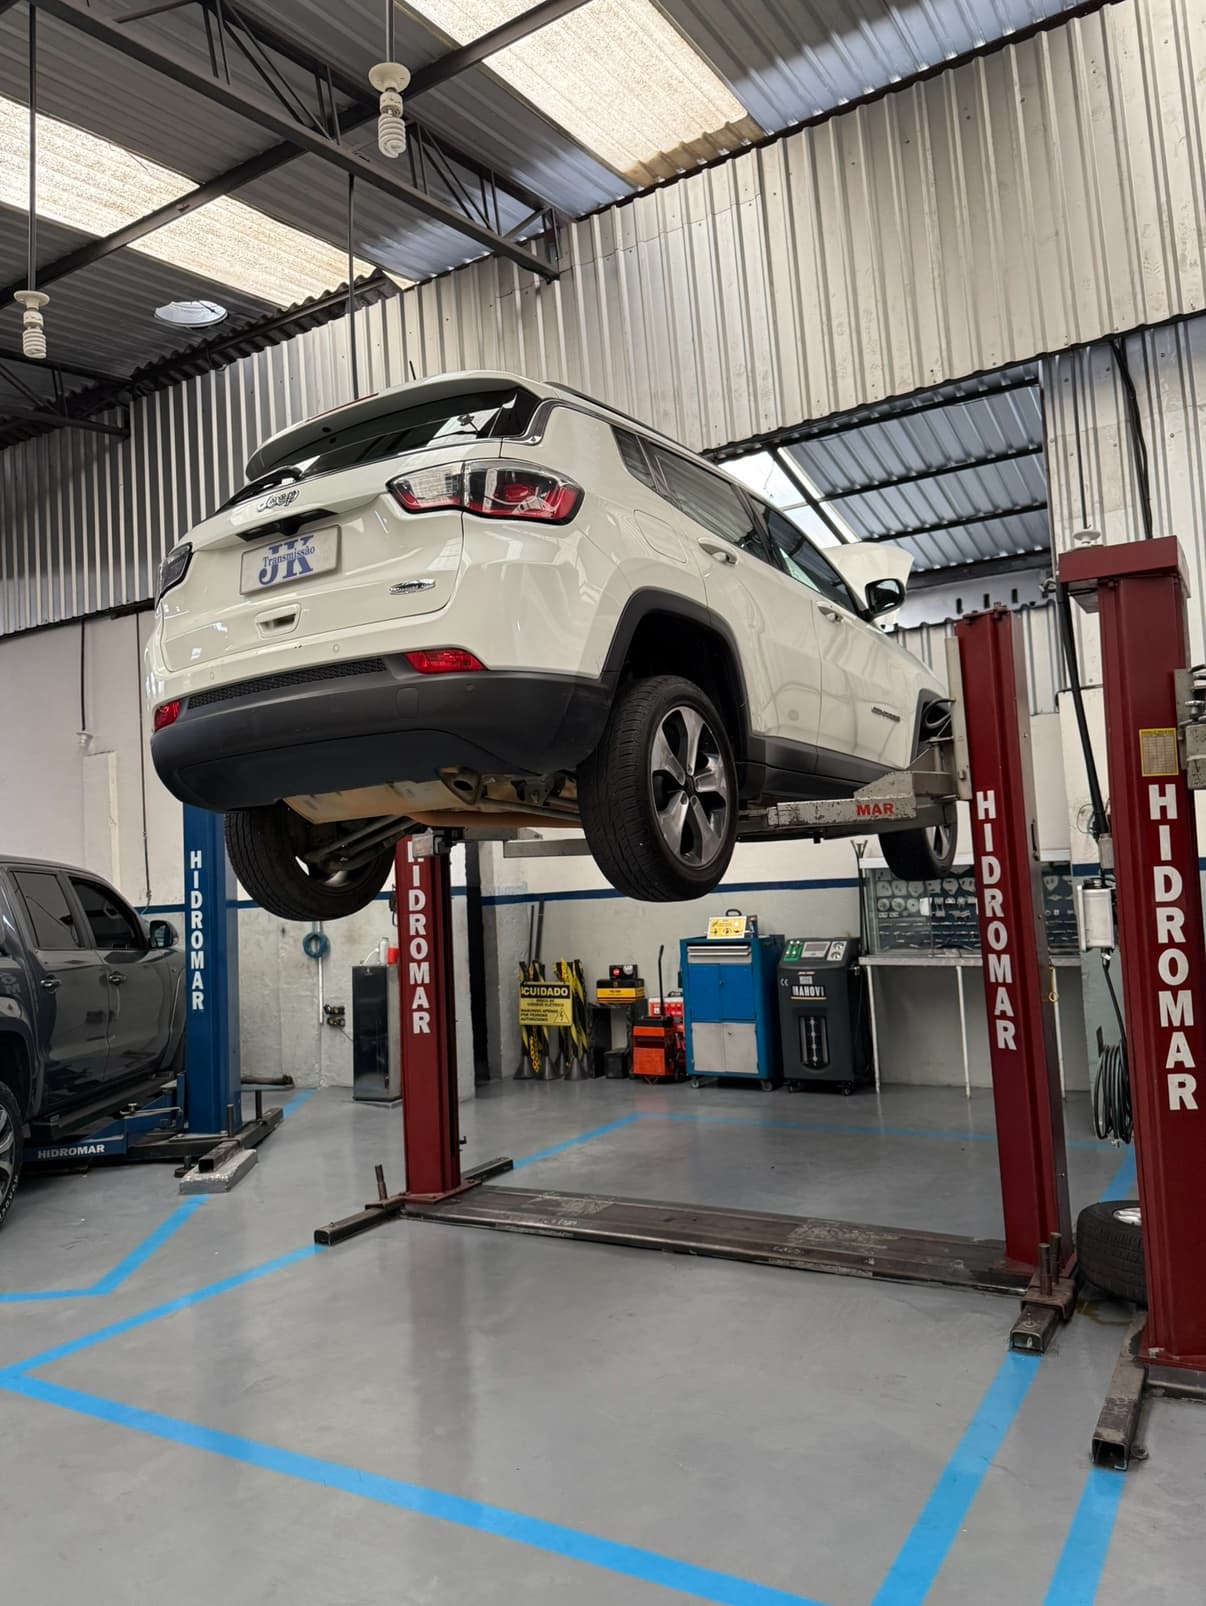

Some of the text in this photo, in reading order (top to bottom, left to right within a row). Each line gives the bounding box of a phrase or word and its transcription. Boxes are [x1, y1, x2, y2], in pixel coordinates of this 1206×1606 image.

[258, 535, 314, 586] JK
[263, 545, 315, 568] Transmissão
[856, 803, 894, 816] MAR
[190, 850, 204, 1011] HIDROMAR
[976, 790, 1017, 1051] HIDROMAR
[1148, 783, 1199, 1111] HIDROMAR
[524, 986, 569, 996] CUIDADO
[37, 1144, 105, 1159] HIDROMAR
